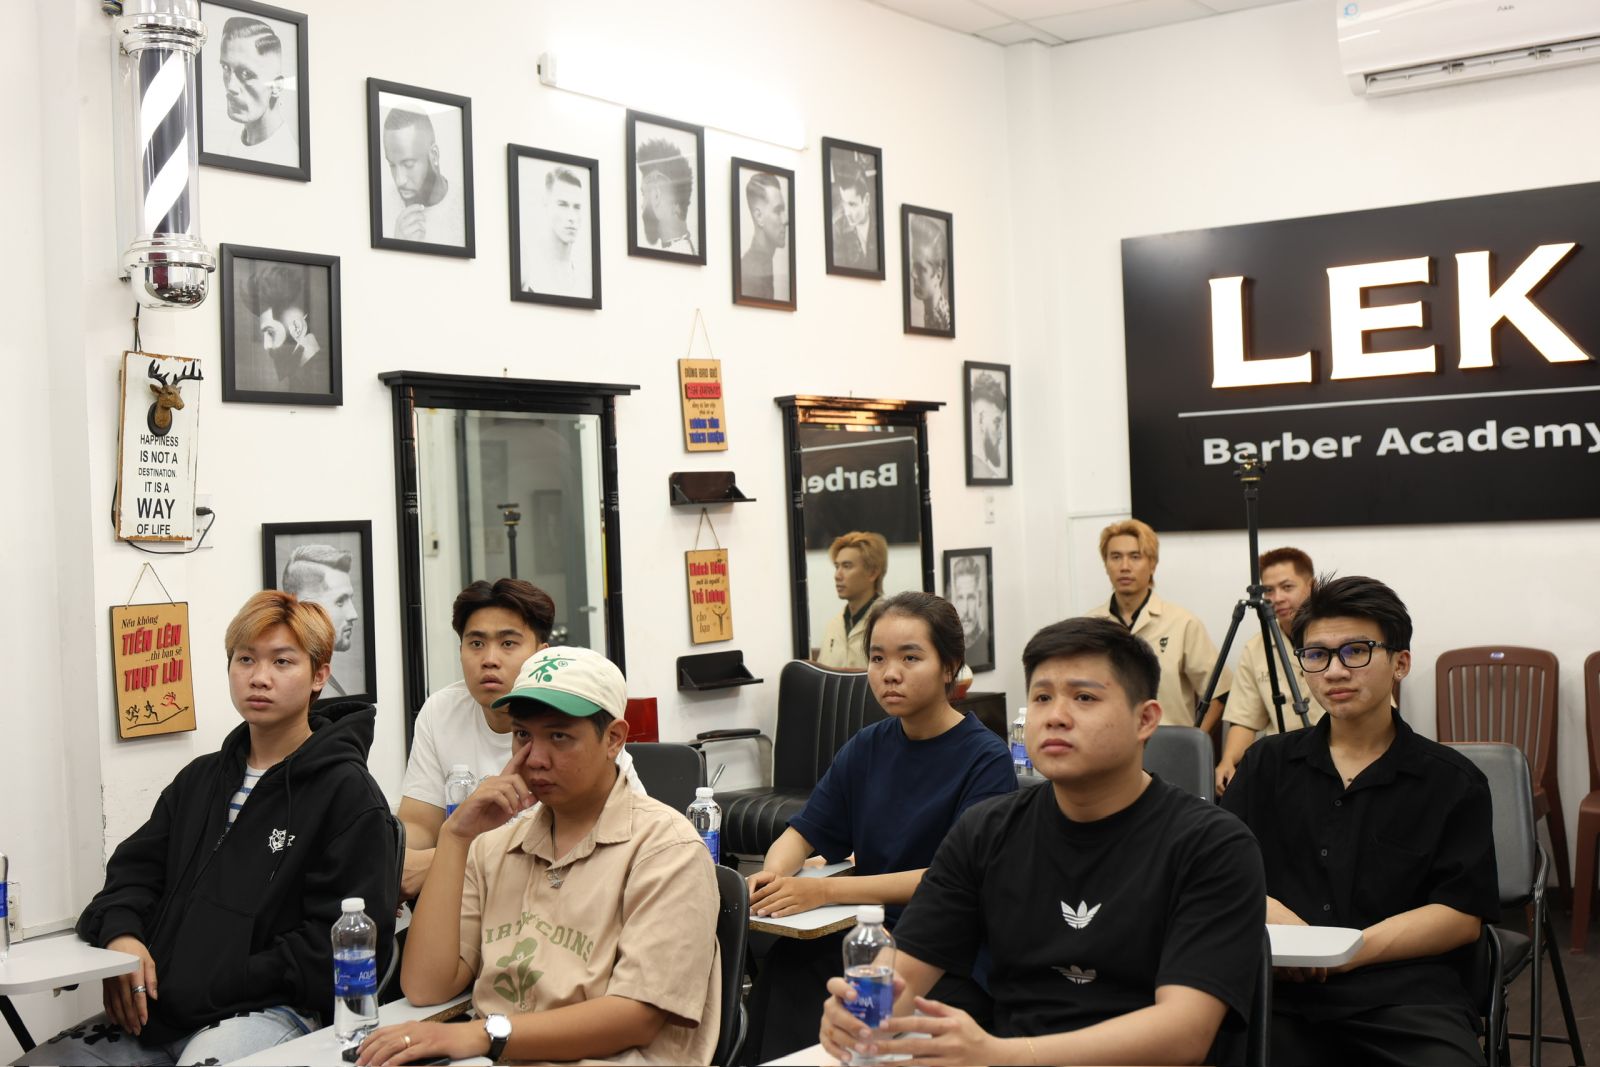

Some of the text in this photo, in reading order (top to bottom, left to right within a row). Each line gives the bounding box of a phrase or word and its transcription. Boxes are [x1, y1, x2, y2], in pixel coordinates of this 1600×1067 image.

[1208, 242, 1592, 388] LEK
[140, 434, 179, 447] HAPPINESS
[1204, 419, 1600, 466] Barber Academy
[140, 450, 178, 464] IS NOT A
[144, 482, 170, 493] IT IS A
[137, 497, 176, 519] WAY
[136, 524, 171, 534] OF LIFE
[122, 622, 182, 656] TIẾN LÊN
[124, 658, 184, 692] THỤT LÙI
